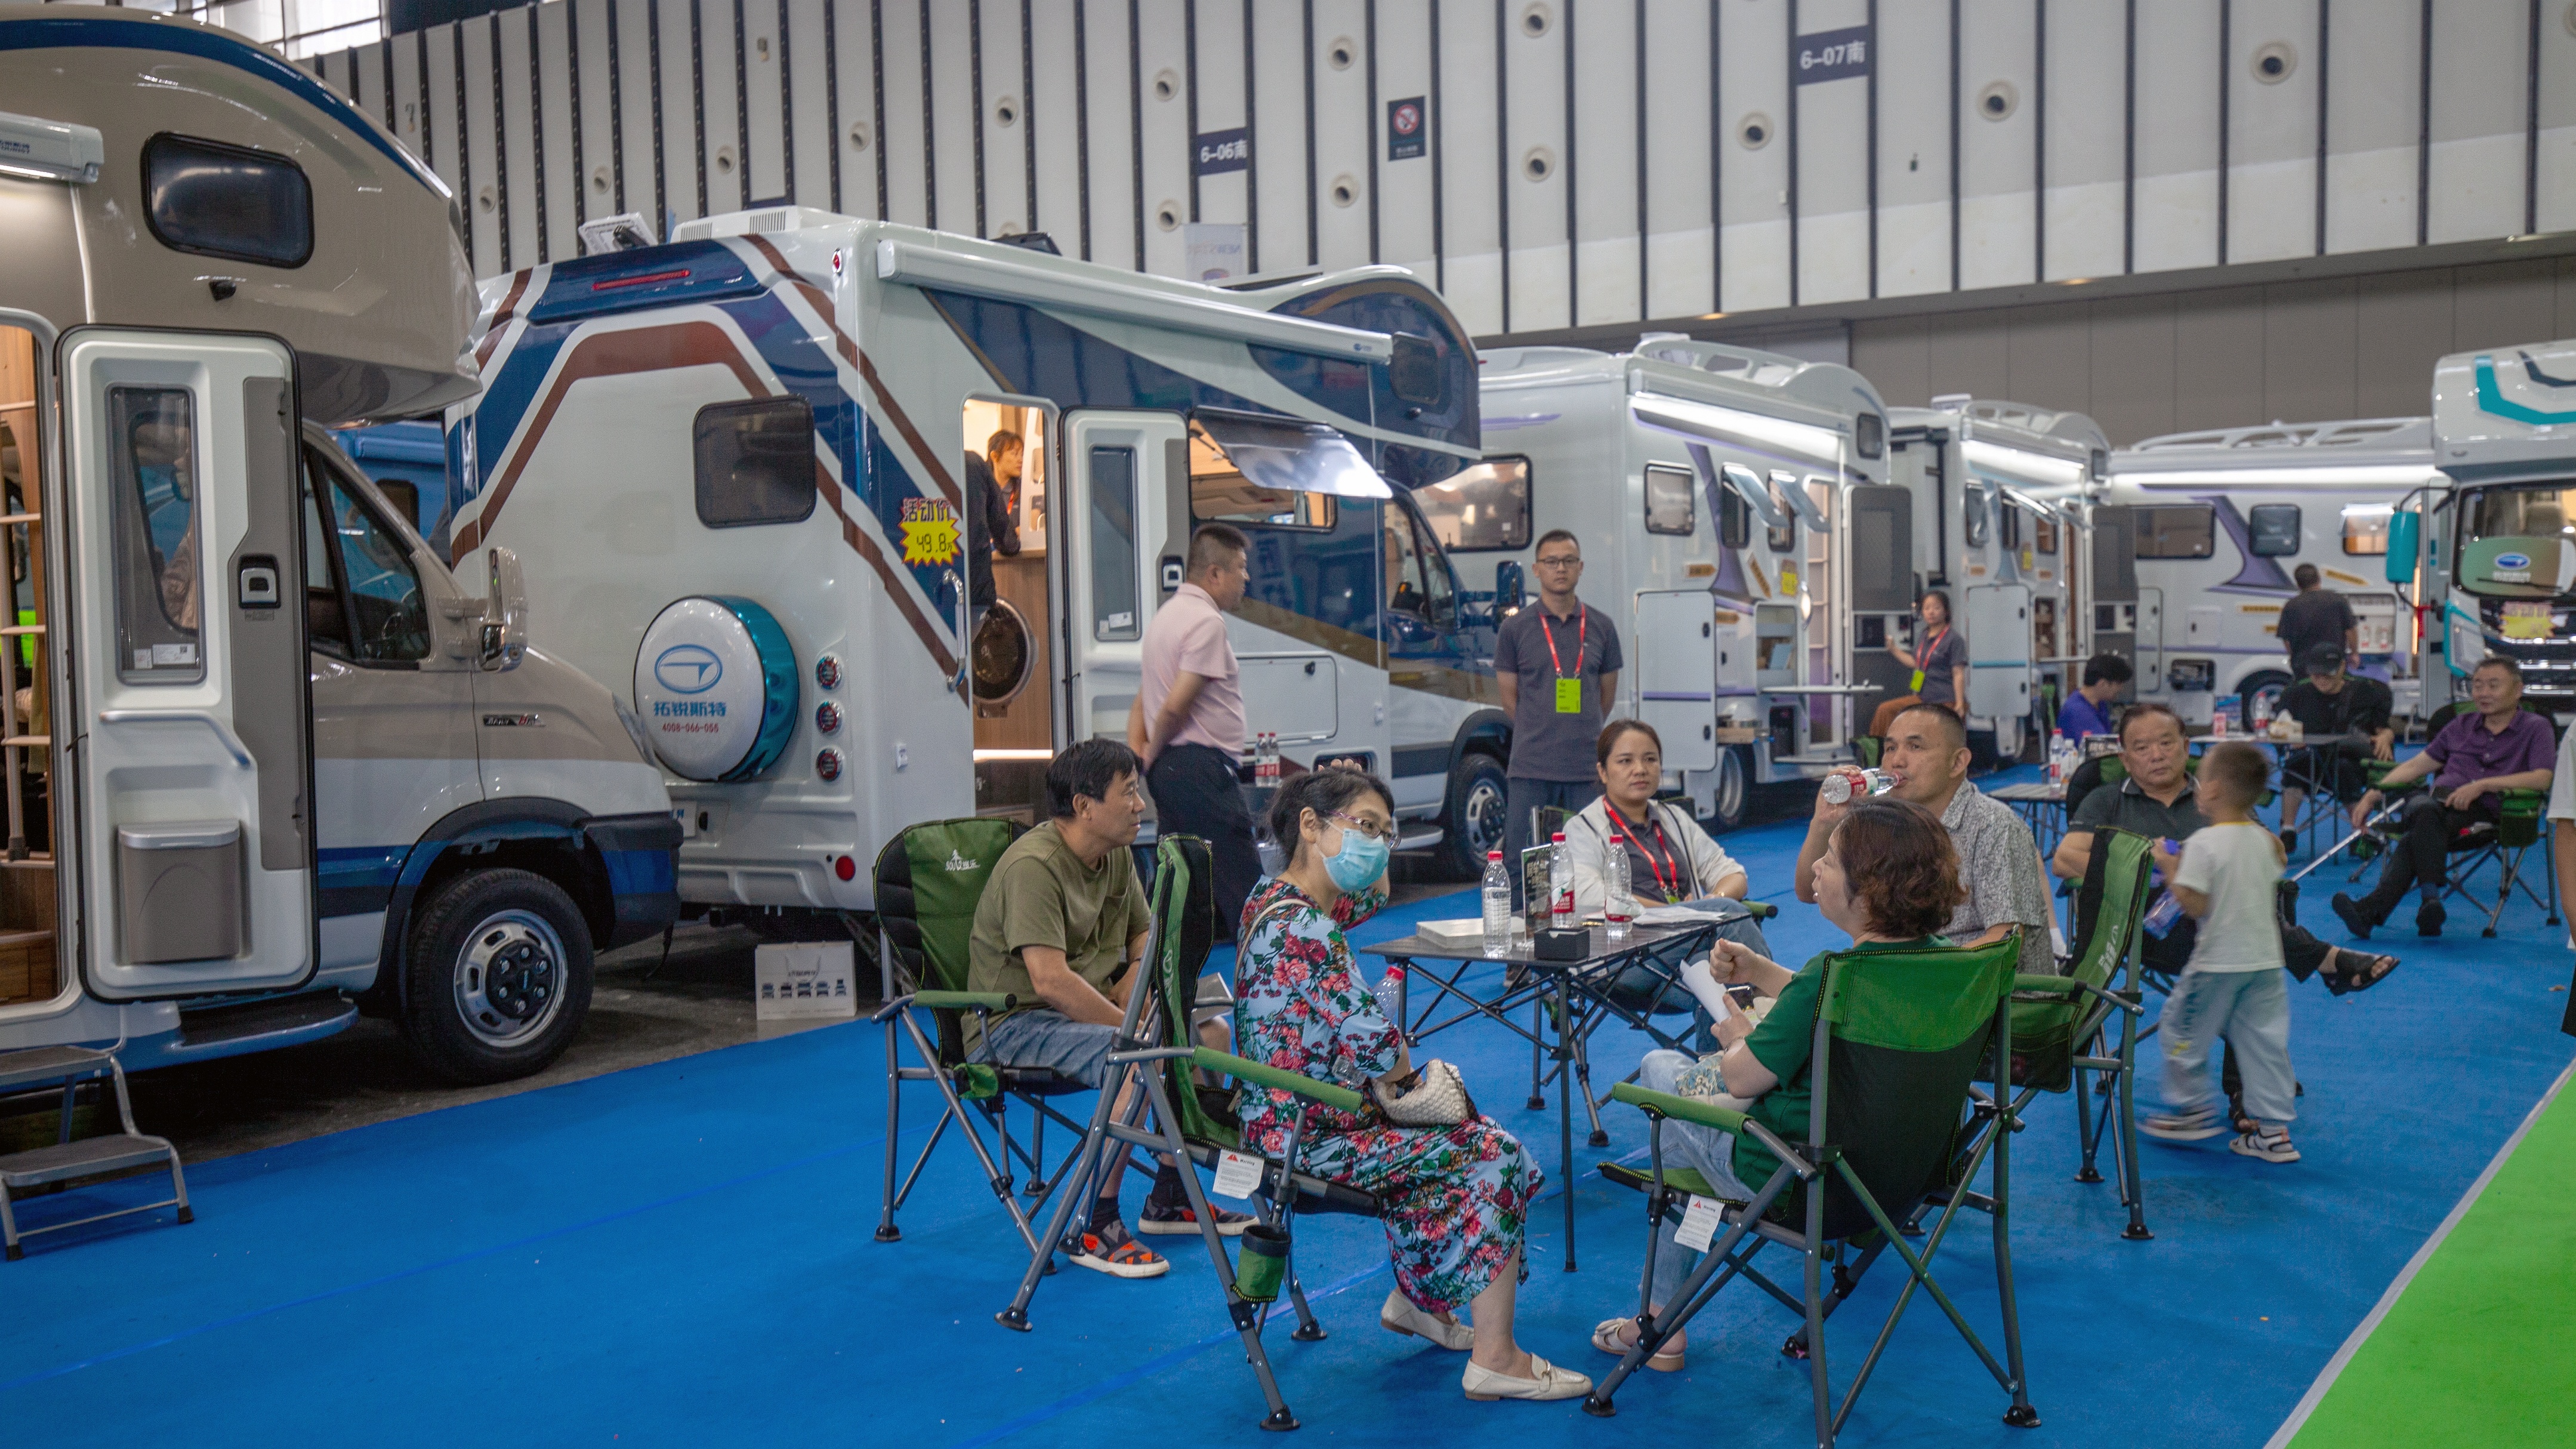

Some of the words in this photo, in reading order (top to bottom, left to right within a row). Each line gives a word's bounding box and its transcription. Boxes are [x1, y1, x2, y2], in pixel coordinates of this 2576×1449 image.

[903, 500, 950, 522] 活动价
[654, 701, 727, 717] 拓锐斯特
[662, 722, 720, 733] 4008-066-055
